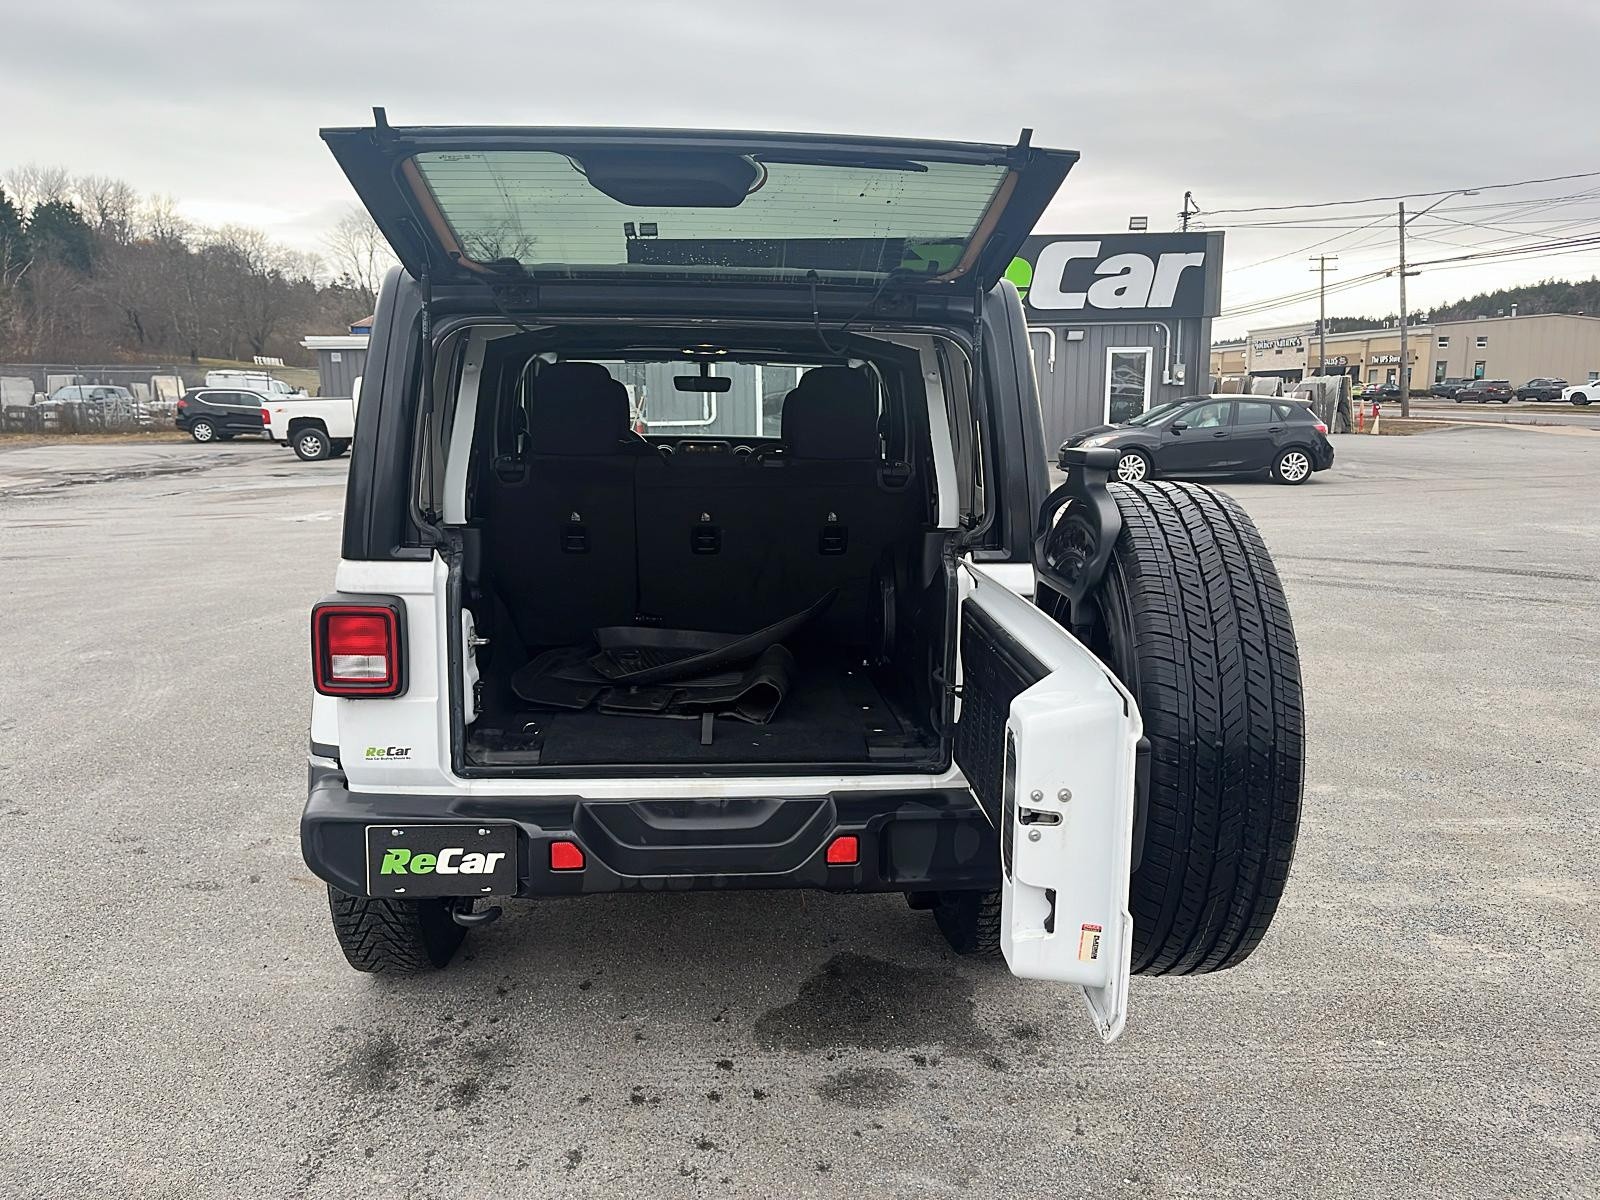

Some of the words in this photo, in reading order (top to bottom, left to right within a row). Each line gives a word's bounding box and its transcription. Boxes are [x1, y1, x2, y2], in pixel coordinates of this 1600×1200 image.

[1380, 355, 1388, 363] UPS
[366, 746, 411, 756] ReCar
[380, 848, 505, 875] ReCar
